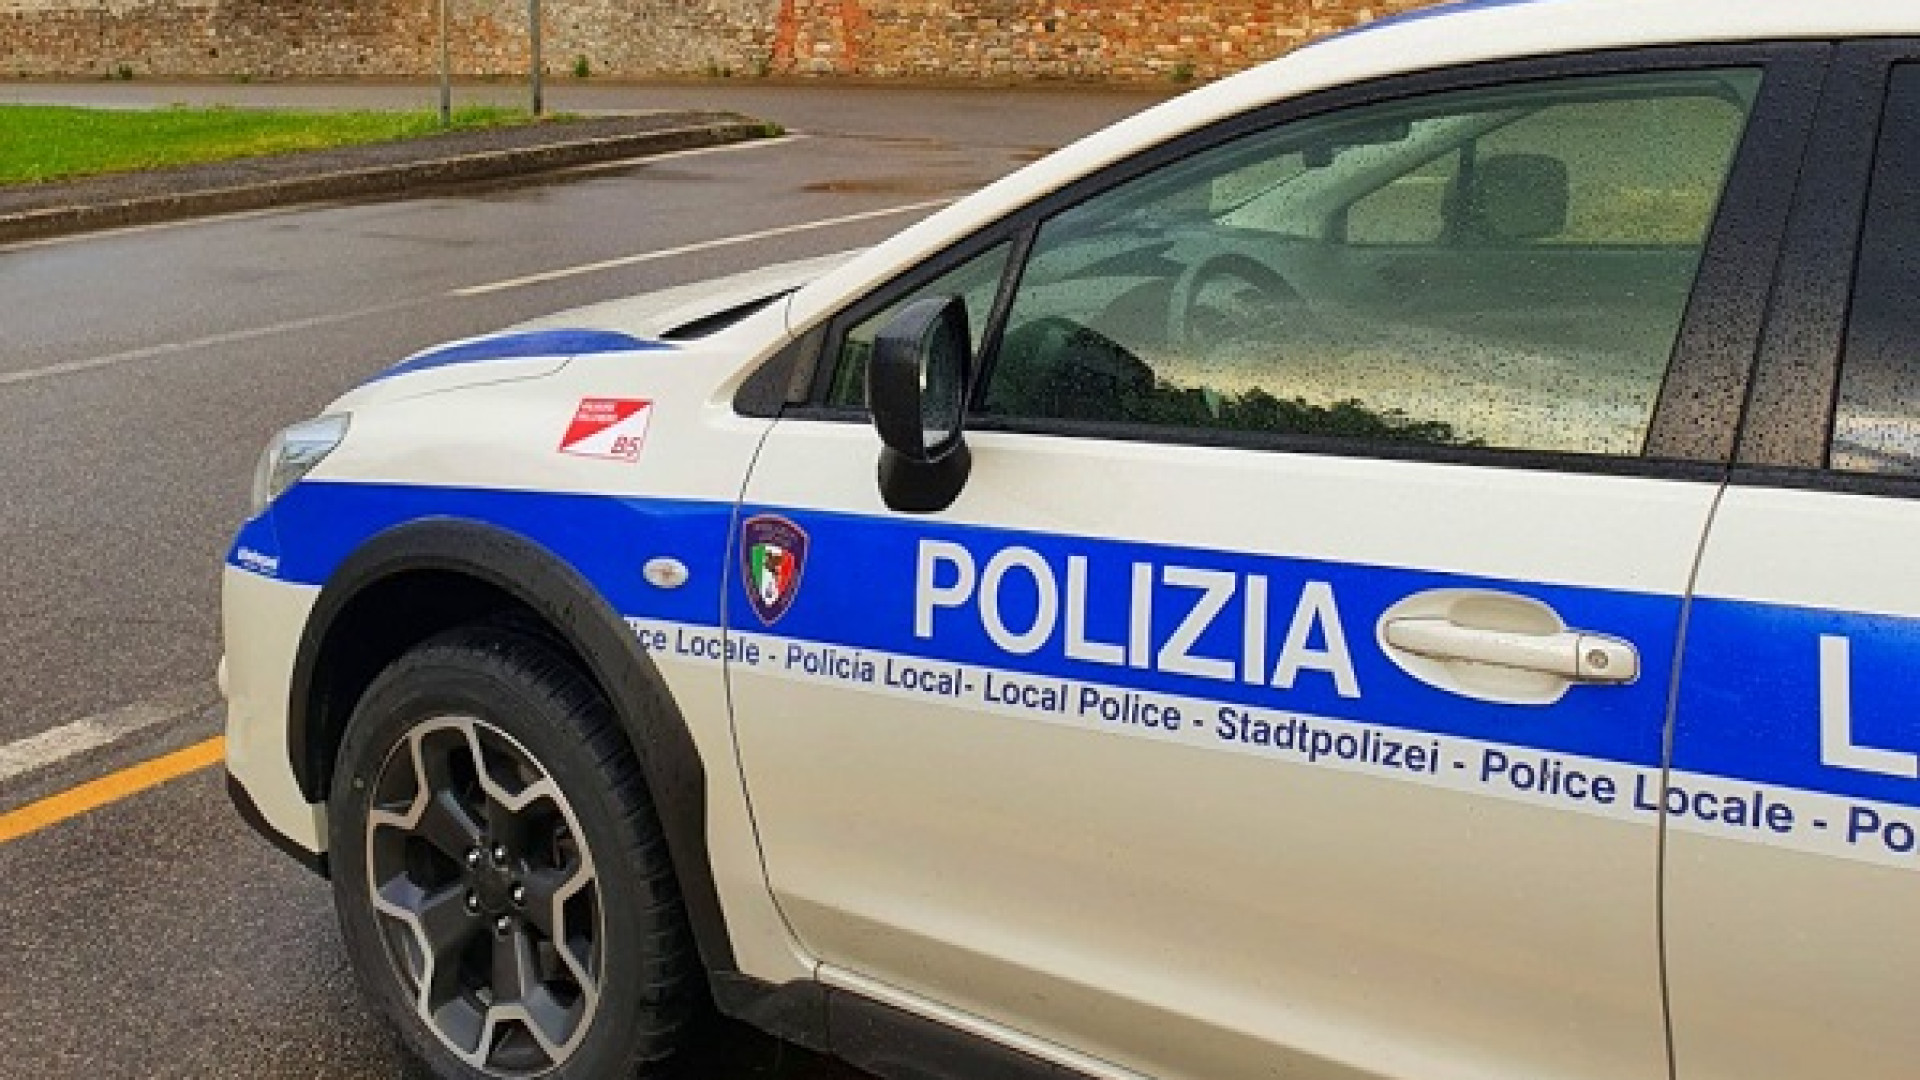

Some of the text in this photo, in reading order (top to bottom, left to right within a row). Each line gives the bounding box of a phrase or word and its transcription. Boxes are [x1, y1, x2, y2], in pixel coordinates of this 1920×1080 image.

[675, 627, 760, 665] Locale
[784, 643, 876, 682] Policia
[983, 673, 1067, 713] Local
[1079, 687, 1181, 730] Police
[1216, 708, 1439, 774] Stadtpolizei
[1480, 748, 1616, 804] Police
[1633, 774, 1795, 832] Locale
[1846, 806, 1915, 853] Po
[913, 538, 1918, 778] POLIZIA L
